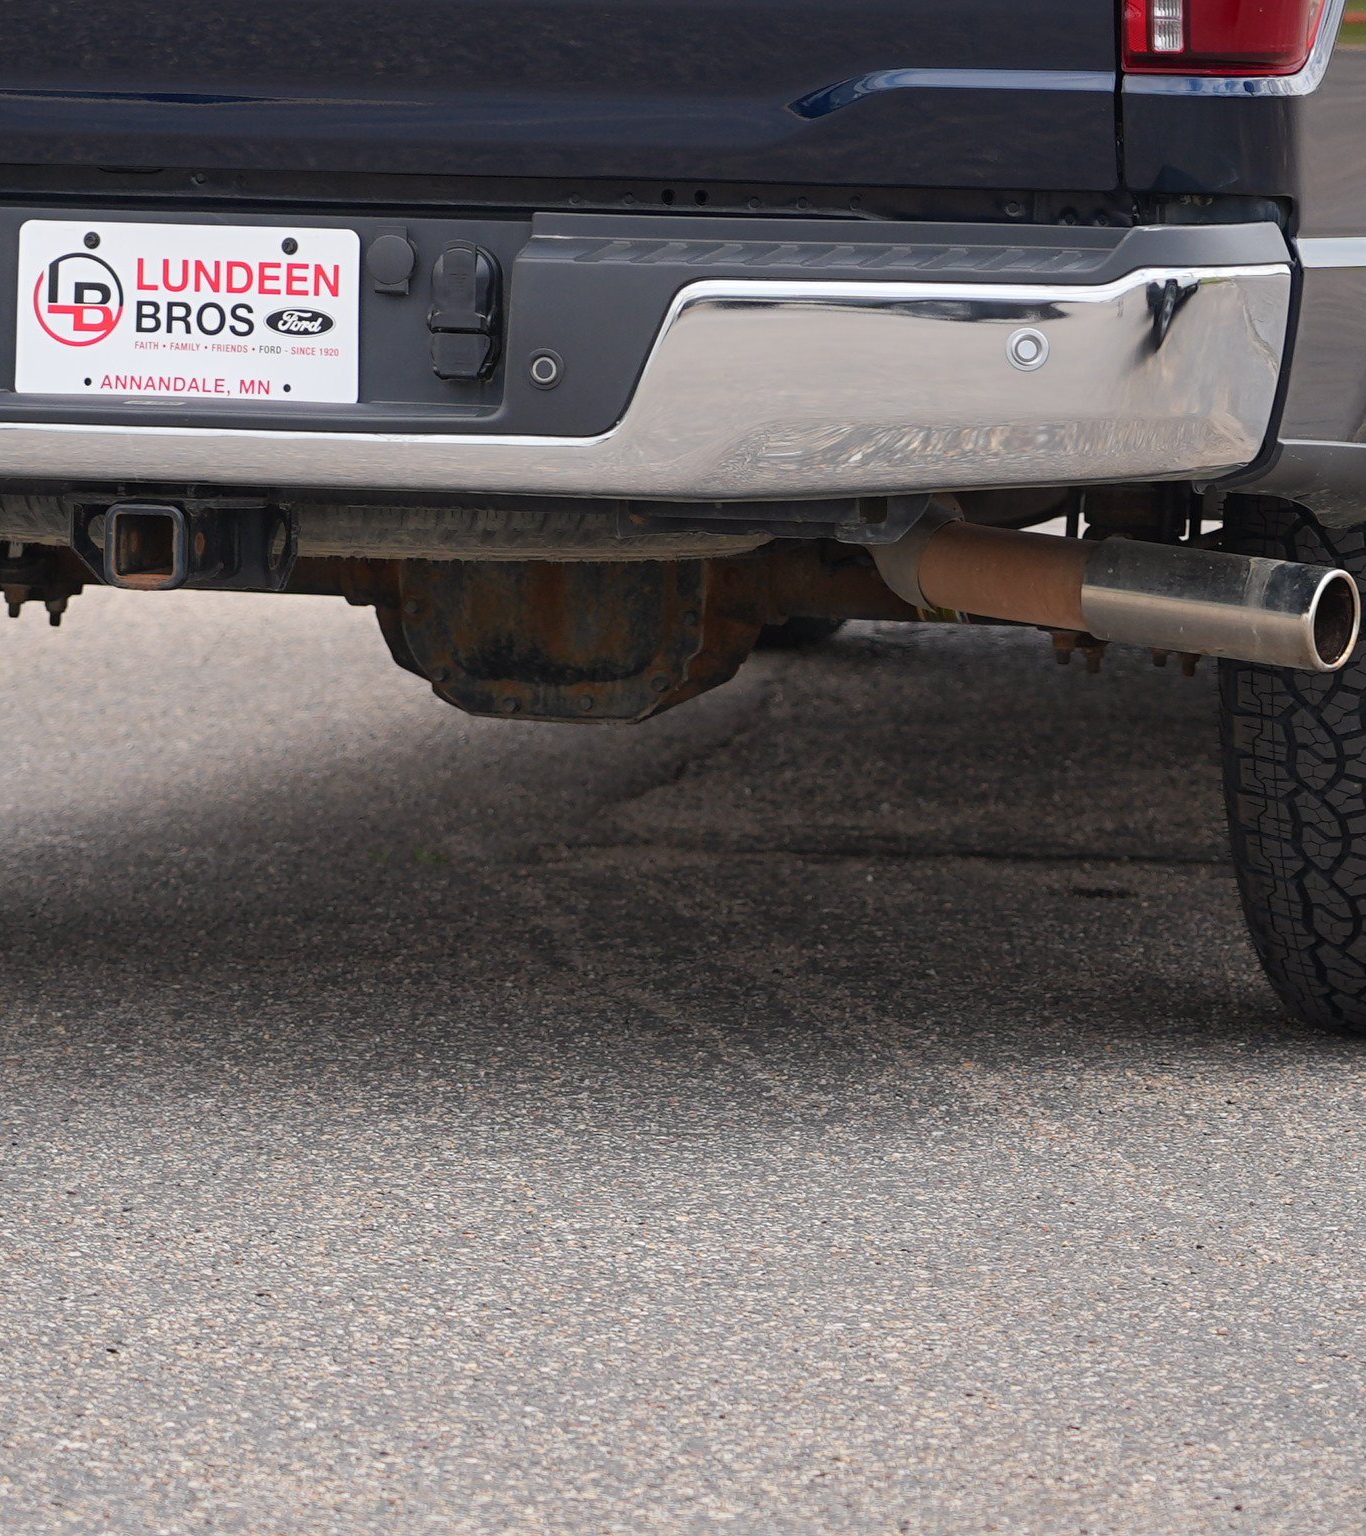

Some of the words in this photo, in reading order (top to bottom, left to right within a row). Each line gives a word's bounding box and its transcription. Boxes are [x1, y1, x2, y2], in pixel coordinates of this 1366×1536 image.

[136, 258, 340, 297] LUNDEEN
[135, 300, 255, 337] BROS
[278, 310, 322, 333] Ford
[134, 341, 159, 350] FAITH
[169, 342, 200, 352] FAMILY
[211, 344, 248, 354] FRIENDS
[258, 345, 282, 355] FORD
[290, 347, 316, 356] SINCE
[319, 348, 340, 357] 1920
[100, 374, 231, 397] ANNANDALE,
[238, 378, 271, 395] MN
